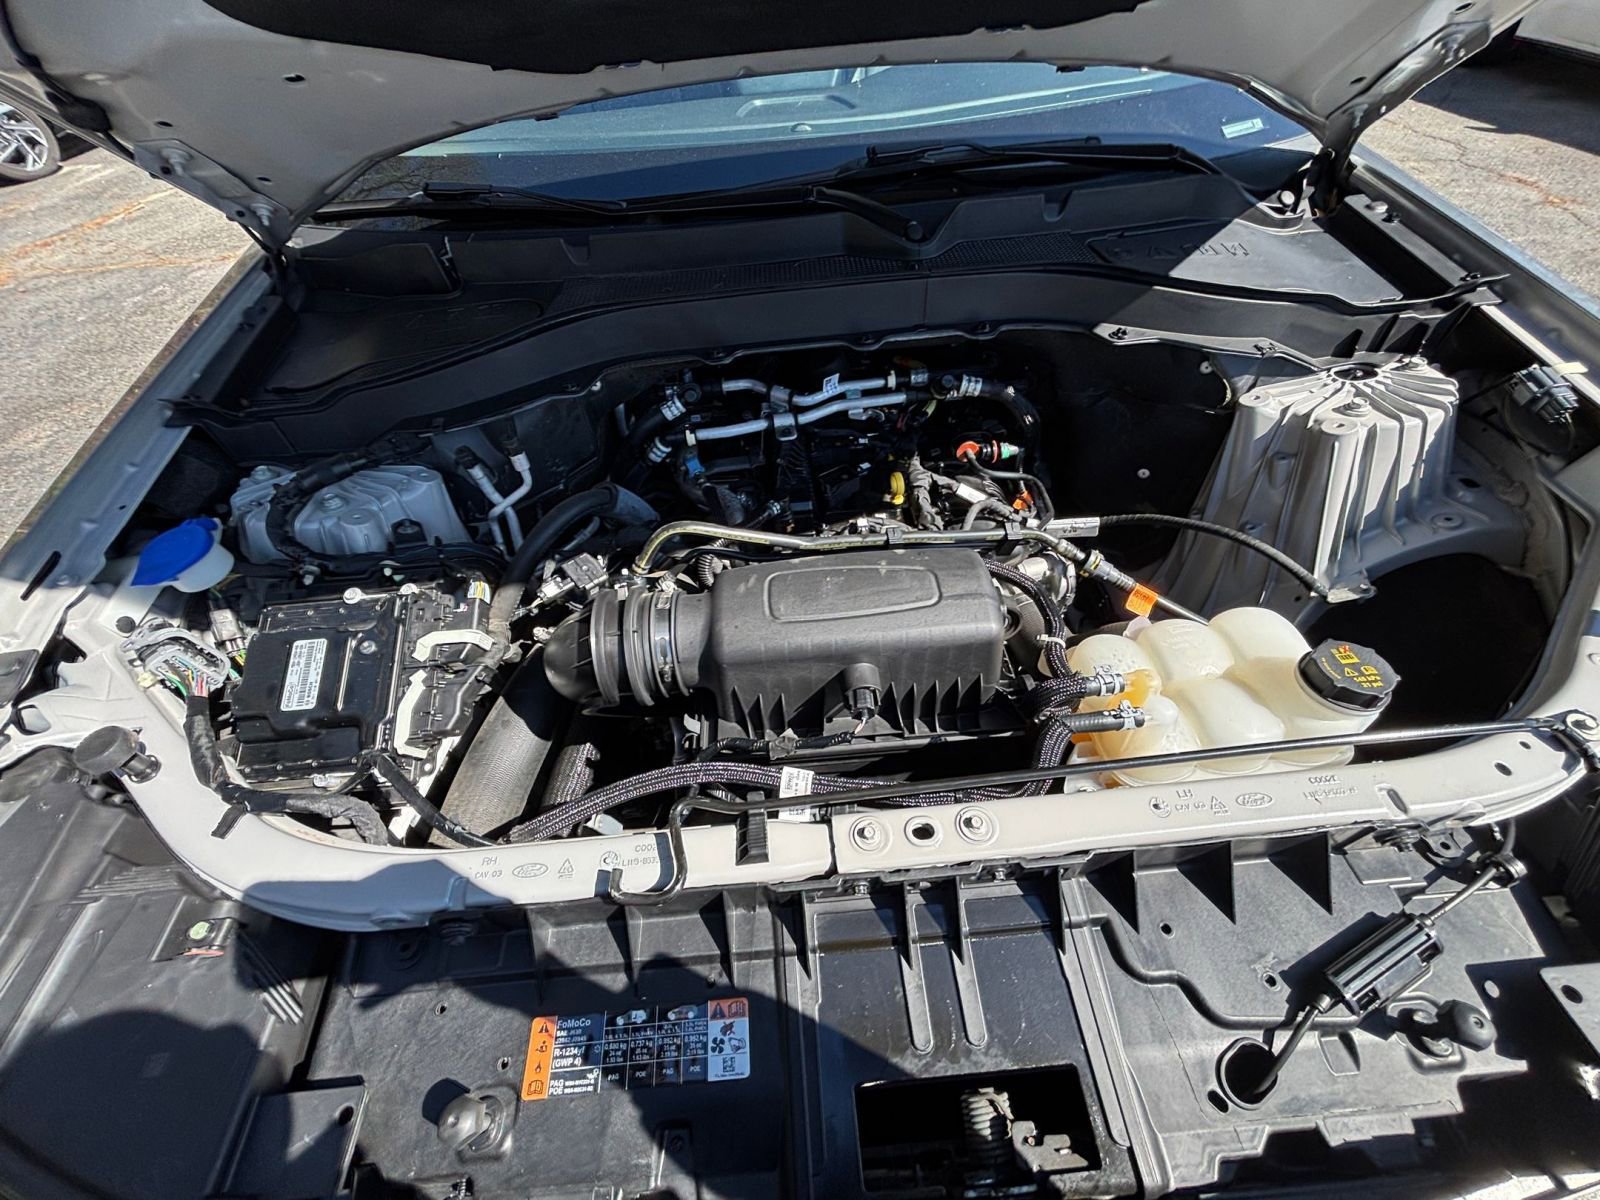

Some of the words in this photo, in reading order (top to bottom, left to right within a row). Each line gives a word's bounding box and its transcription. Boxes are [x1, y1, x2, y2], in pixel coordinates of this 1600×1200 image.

[481, 855, 498, 866] RH
[474, 870, 489, 879] CAV
[491, 869, 503, 878] 03
[557, 1017, 591, 1029] FoMoCo
[553, 1045, 586, 1057] R-1234yf
[552, 1057, 573, 1069] (GWP
[573, 1056, 582, 1067] 4)
[550, 1079, 564, 1088] PAG
[549, 1087, 563, 1095] POE
